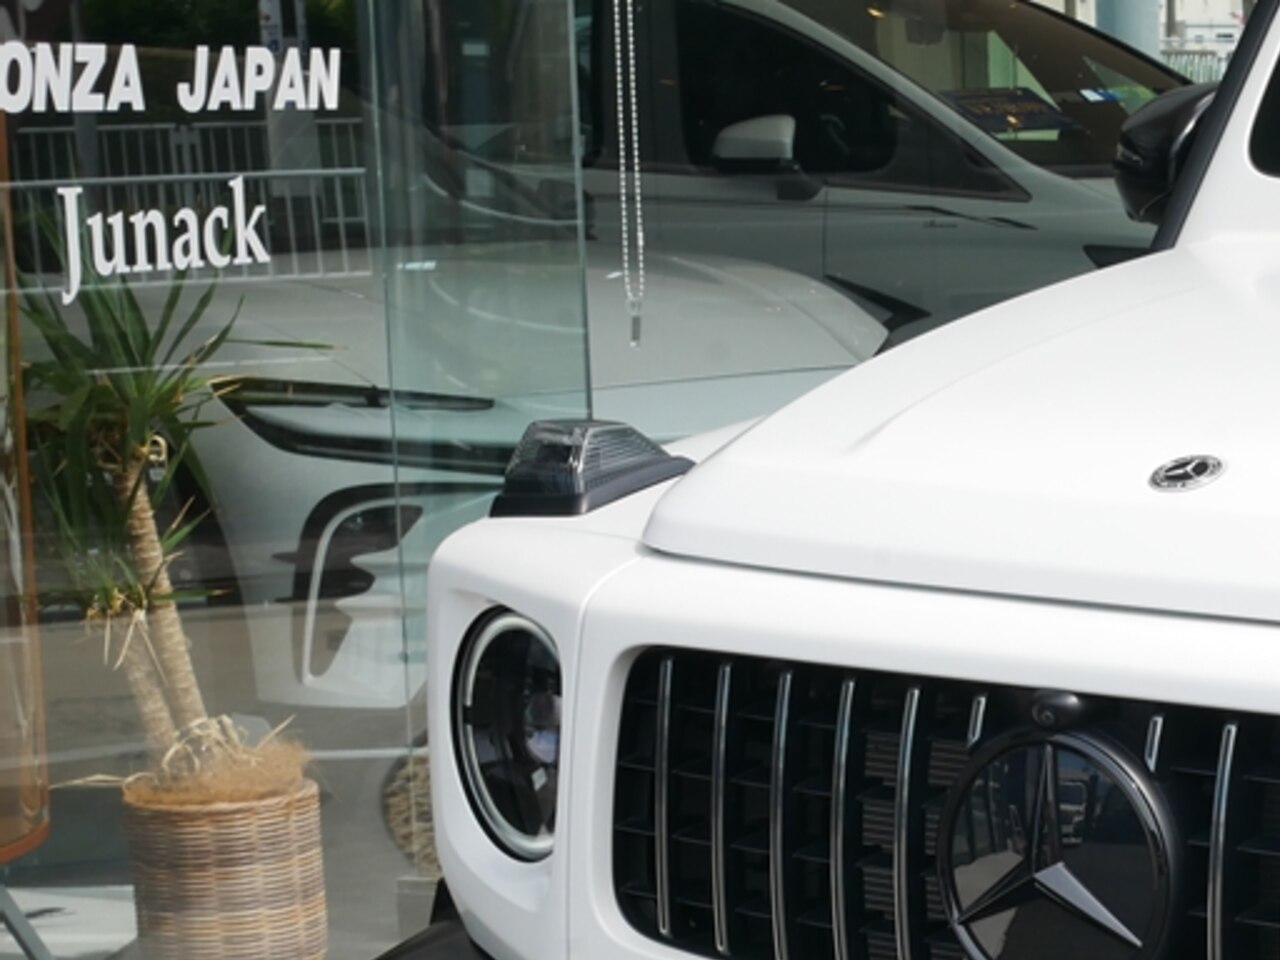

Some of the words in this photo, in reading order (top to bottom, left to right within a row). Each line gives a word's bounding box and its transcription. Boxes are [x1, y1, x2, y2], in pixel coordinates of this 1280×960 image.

[0, 40, 146, 114] ONZA
[176, 44, 341, 113] JAPAN
[56, 174, 271, 305] Junack
